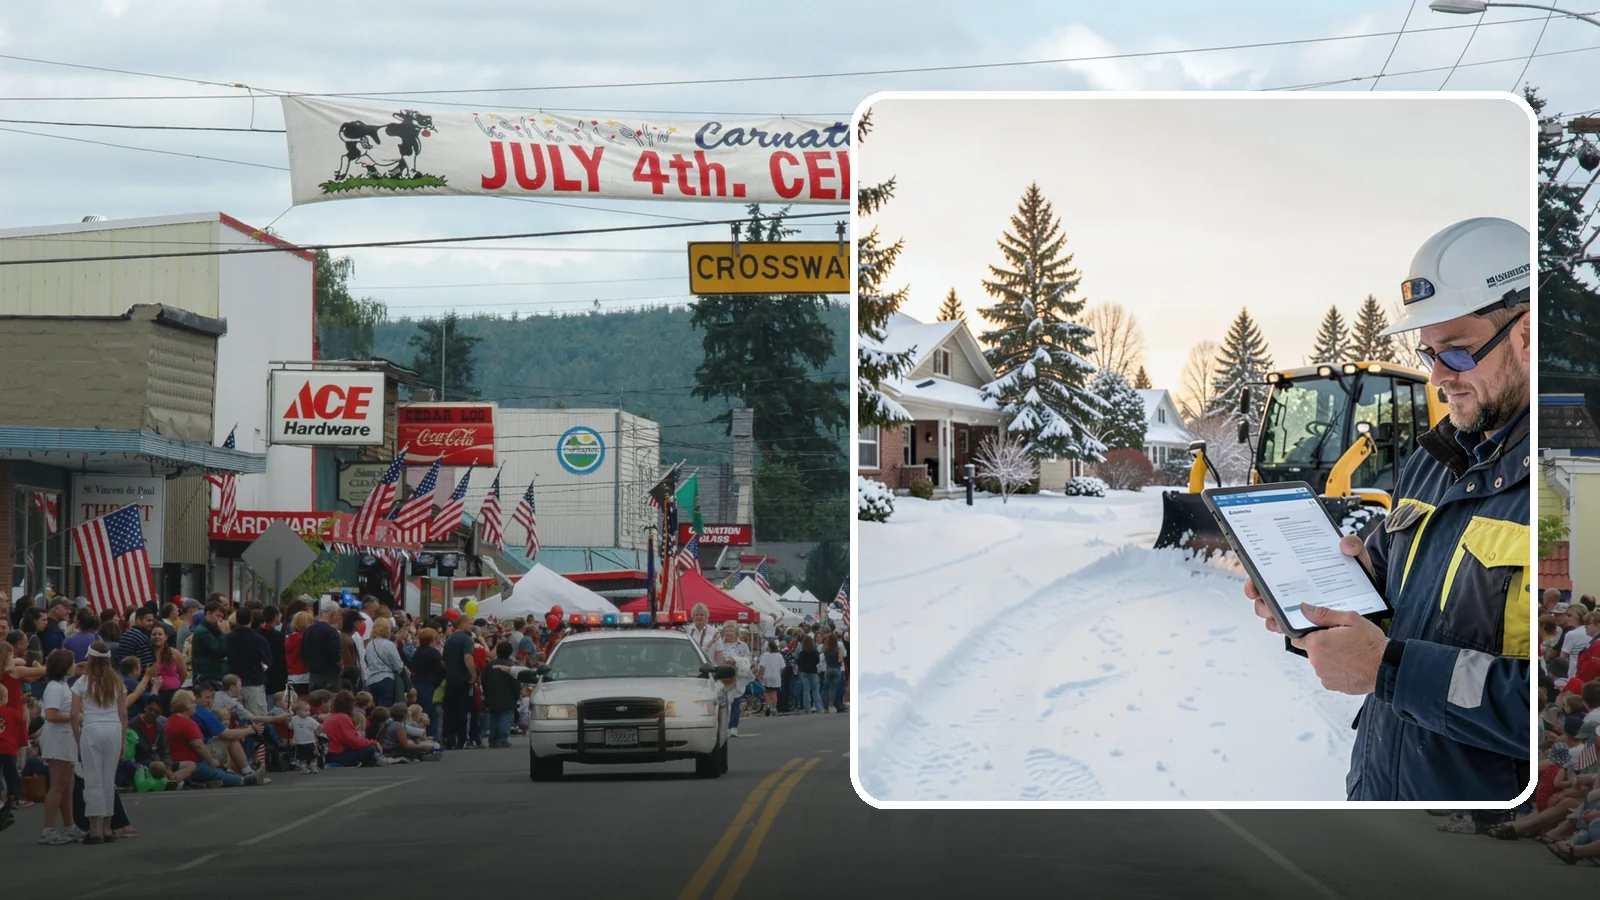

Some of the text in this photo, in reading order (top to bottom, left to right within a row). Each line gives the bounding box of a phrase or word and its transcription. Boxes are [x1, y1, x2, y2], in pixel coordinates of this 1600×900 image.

[694, 121, 850, 150] Carnat
[480, 141, 605, 193] JULY
[632, 149, 746, 198] 4th.
[696, 253, 850, 280] CROSSWA
[283, 380, 374, 420] ACE
[405, 409, 485, 422] CEDAR LOG
[283, 421, 371, 437] Hardware
[353, 466, 387, 480] Simpl
[95, 485, 124, 495] Vincent
[127, 485, 136, 495] de
[138, 485, 155, 495] Paul
[688, 526, 742, 535] CRNATION
[699, 535, 730, 543] GLASS
